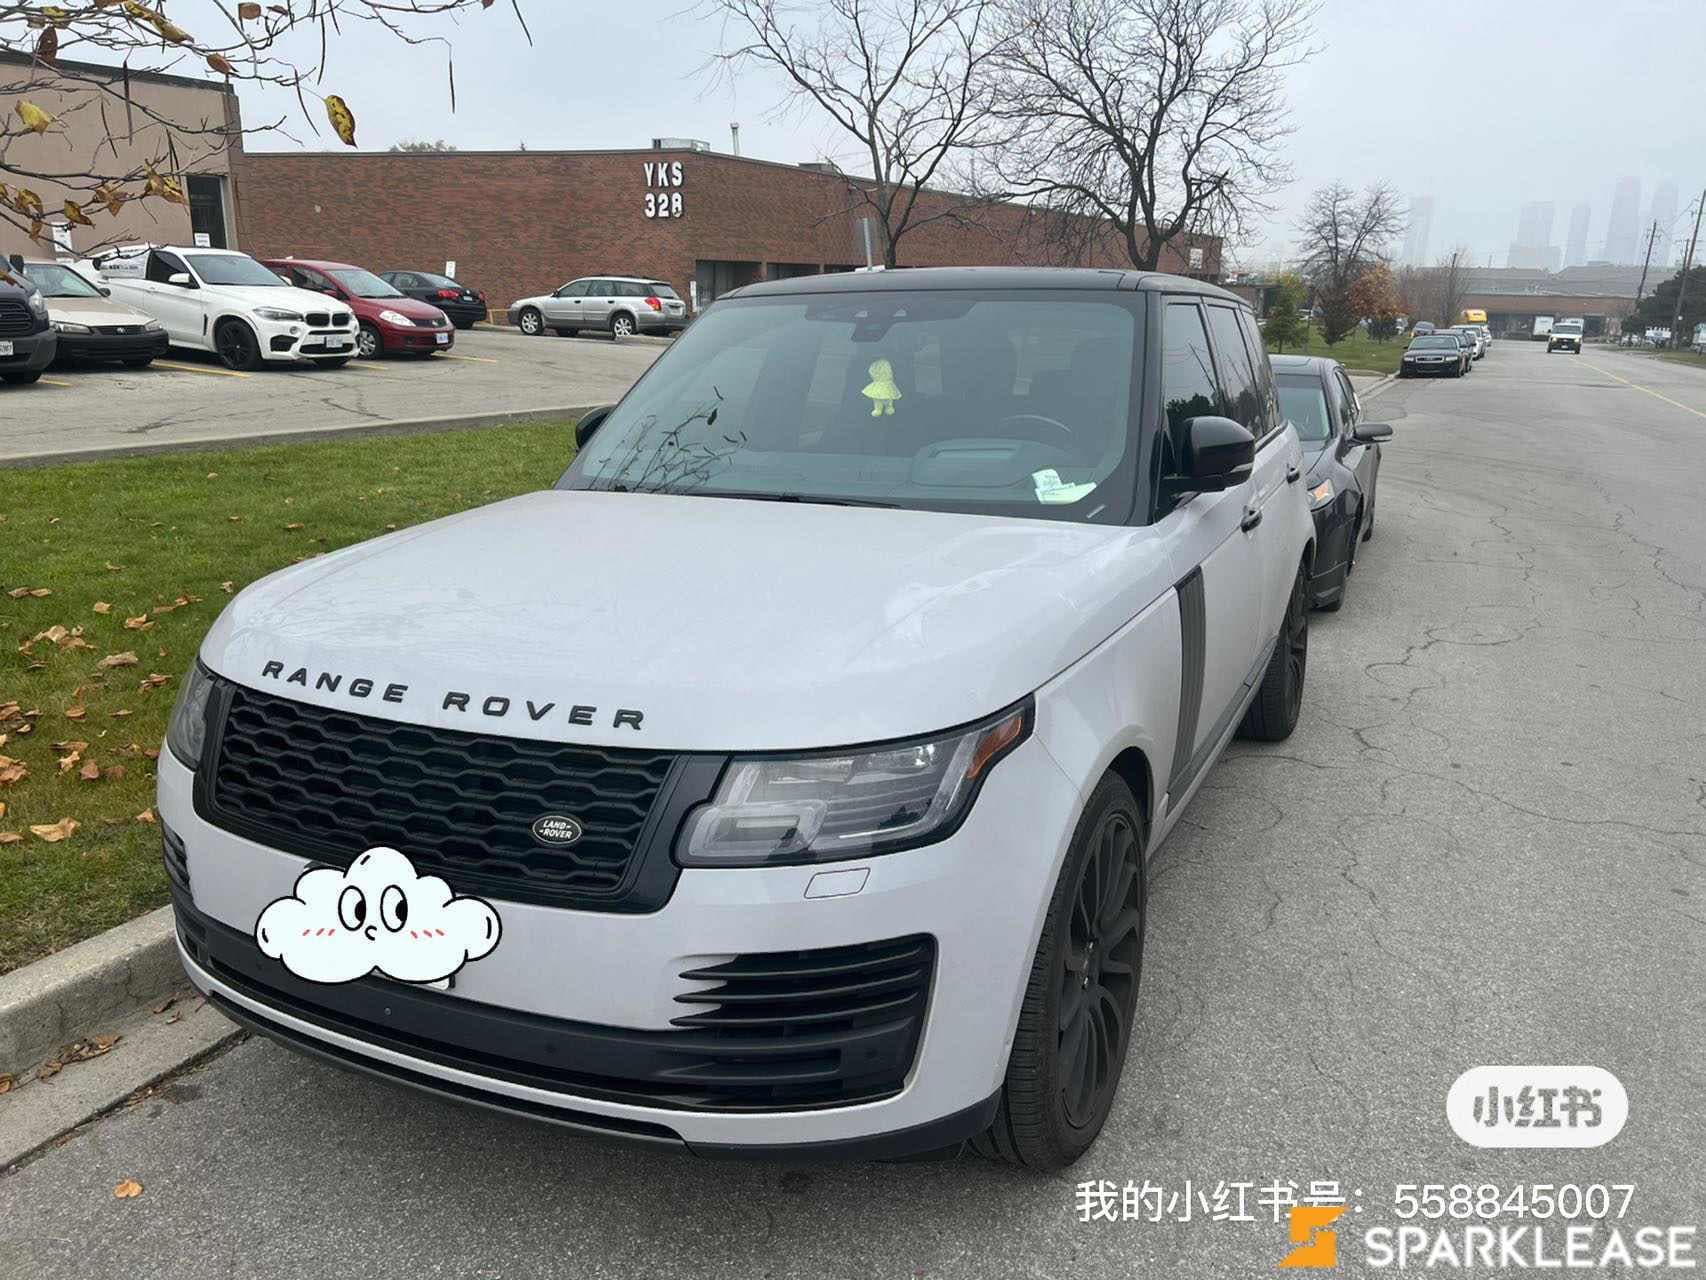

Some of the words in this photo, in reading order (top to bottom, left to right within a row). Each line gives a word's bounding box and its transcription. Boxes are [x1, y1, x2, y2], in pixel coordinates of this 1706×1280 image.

[643, 161, 683, 187] YKS
[644, 192, 683, 218] 328
[261, 660, 408, 703] RANGE
[441, 691, 645, 731] ROVER
